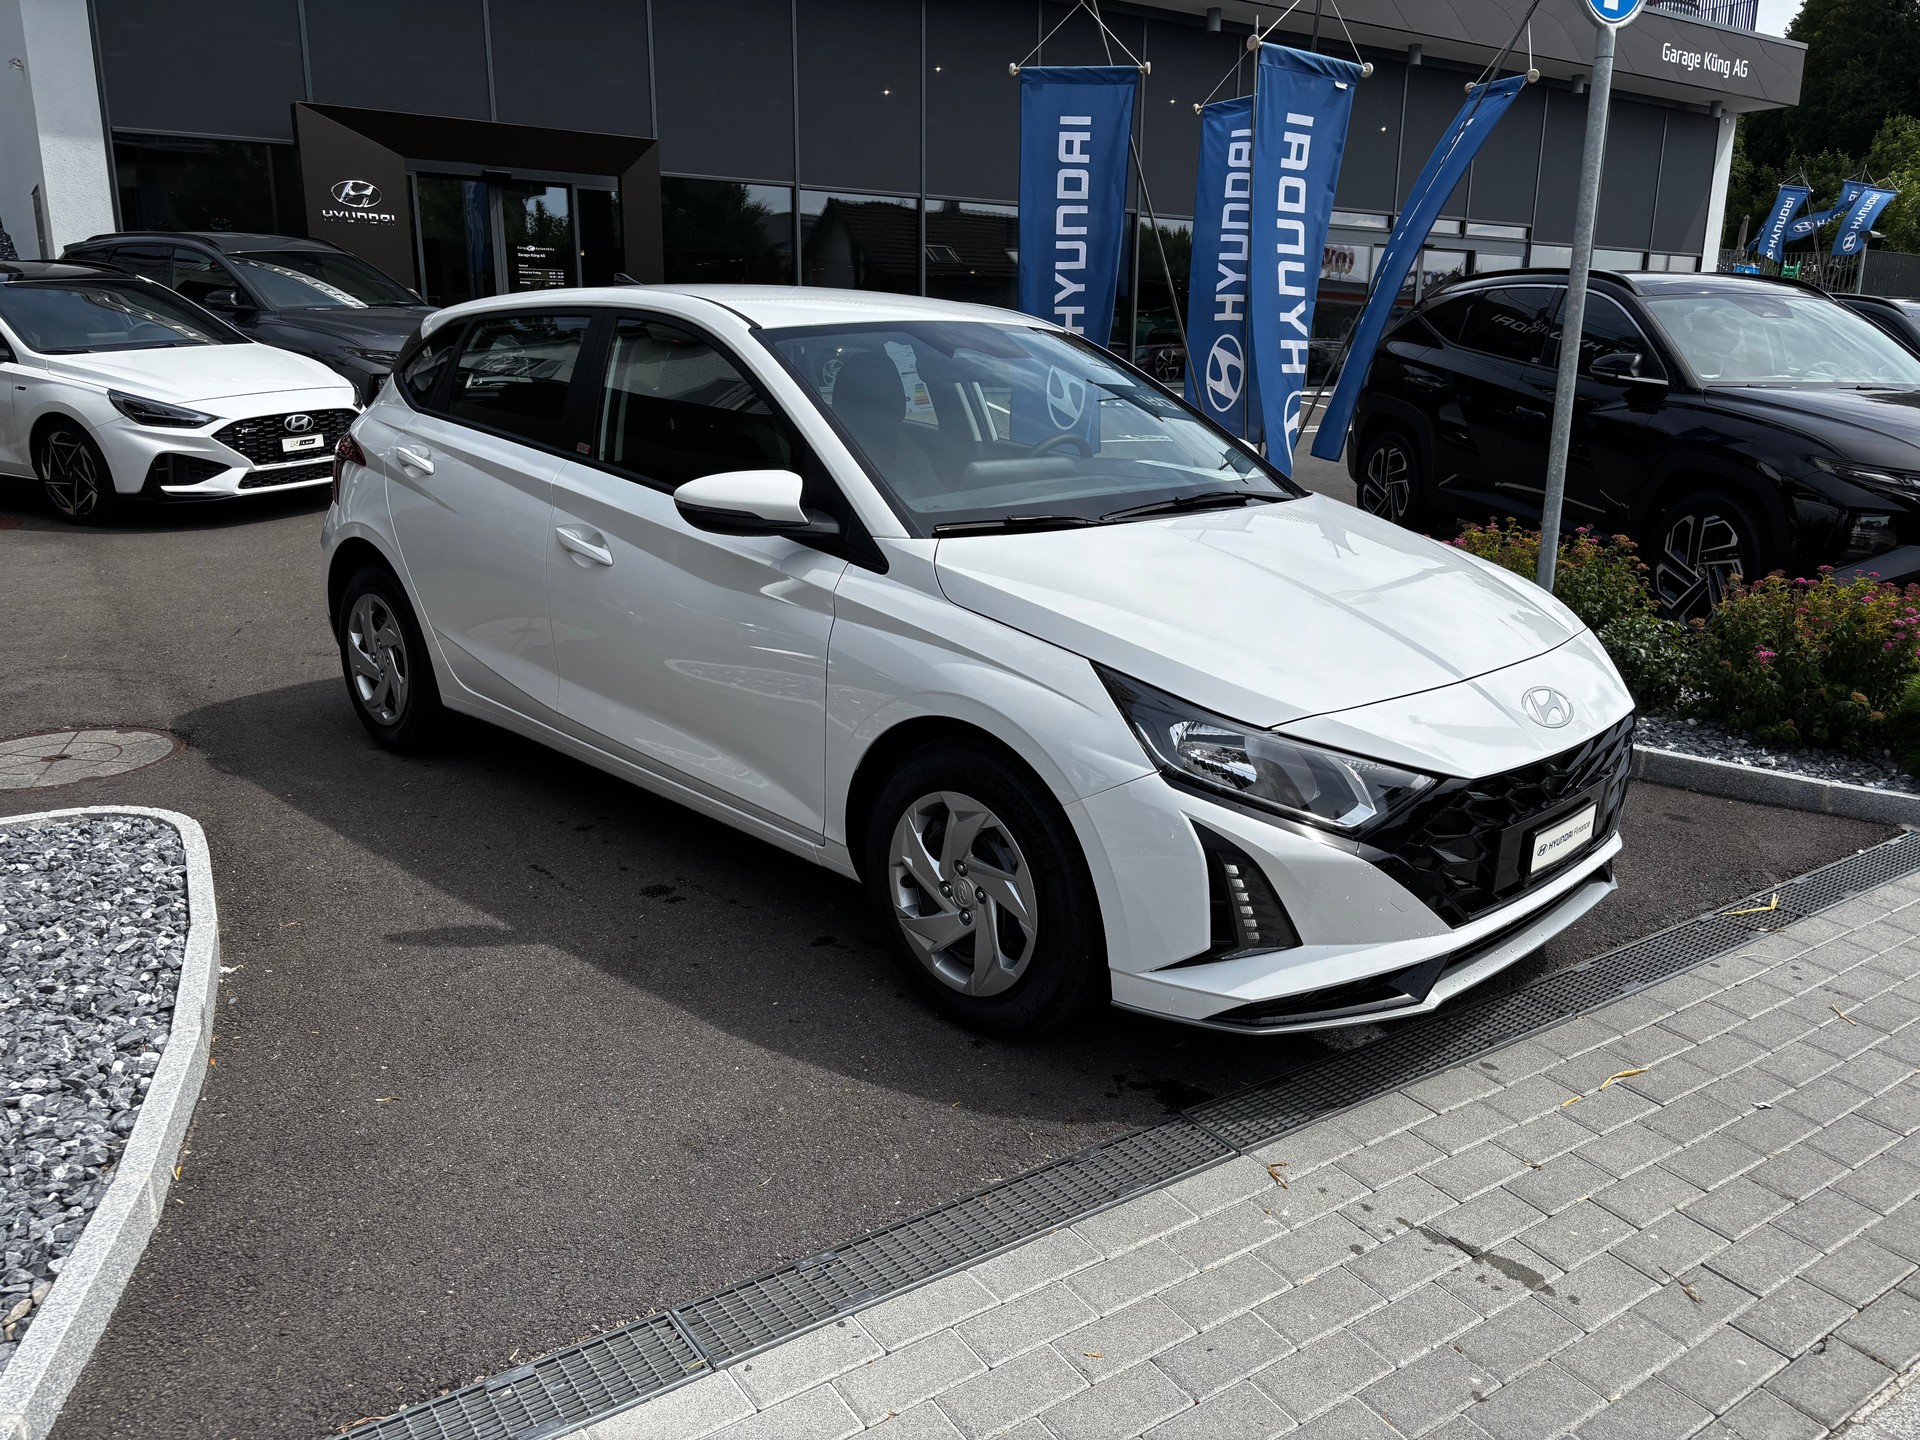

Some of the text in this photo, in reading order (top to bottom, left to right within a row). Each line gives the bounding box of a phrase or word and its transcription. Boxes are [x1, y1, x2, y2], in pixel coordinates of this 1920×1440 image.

[1662, 42, 1749, 79] Garage Küng AG
[1054, 116, 1092, 334] HYUNDAI
[1214, 129, 1252, 321] HYUNDAI
[1548, 820, 1591, 850] HYUNDAI Finance
